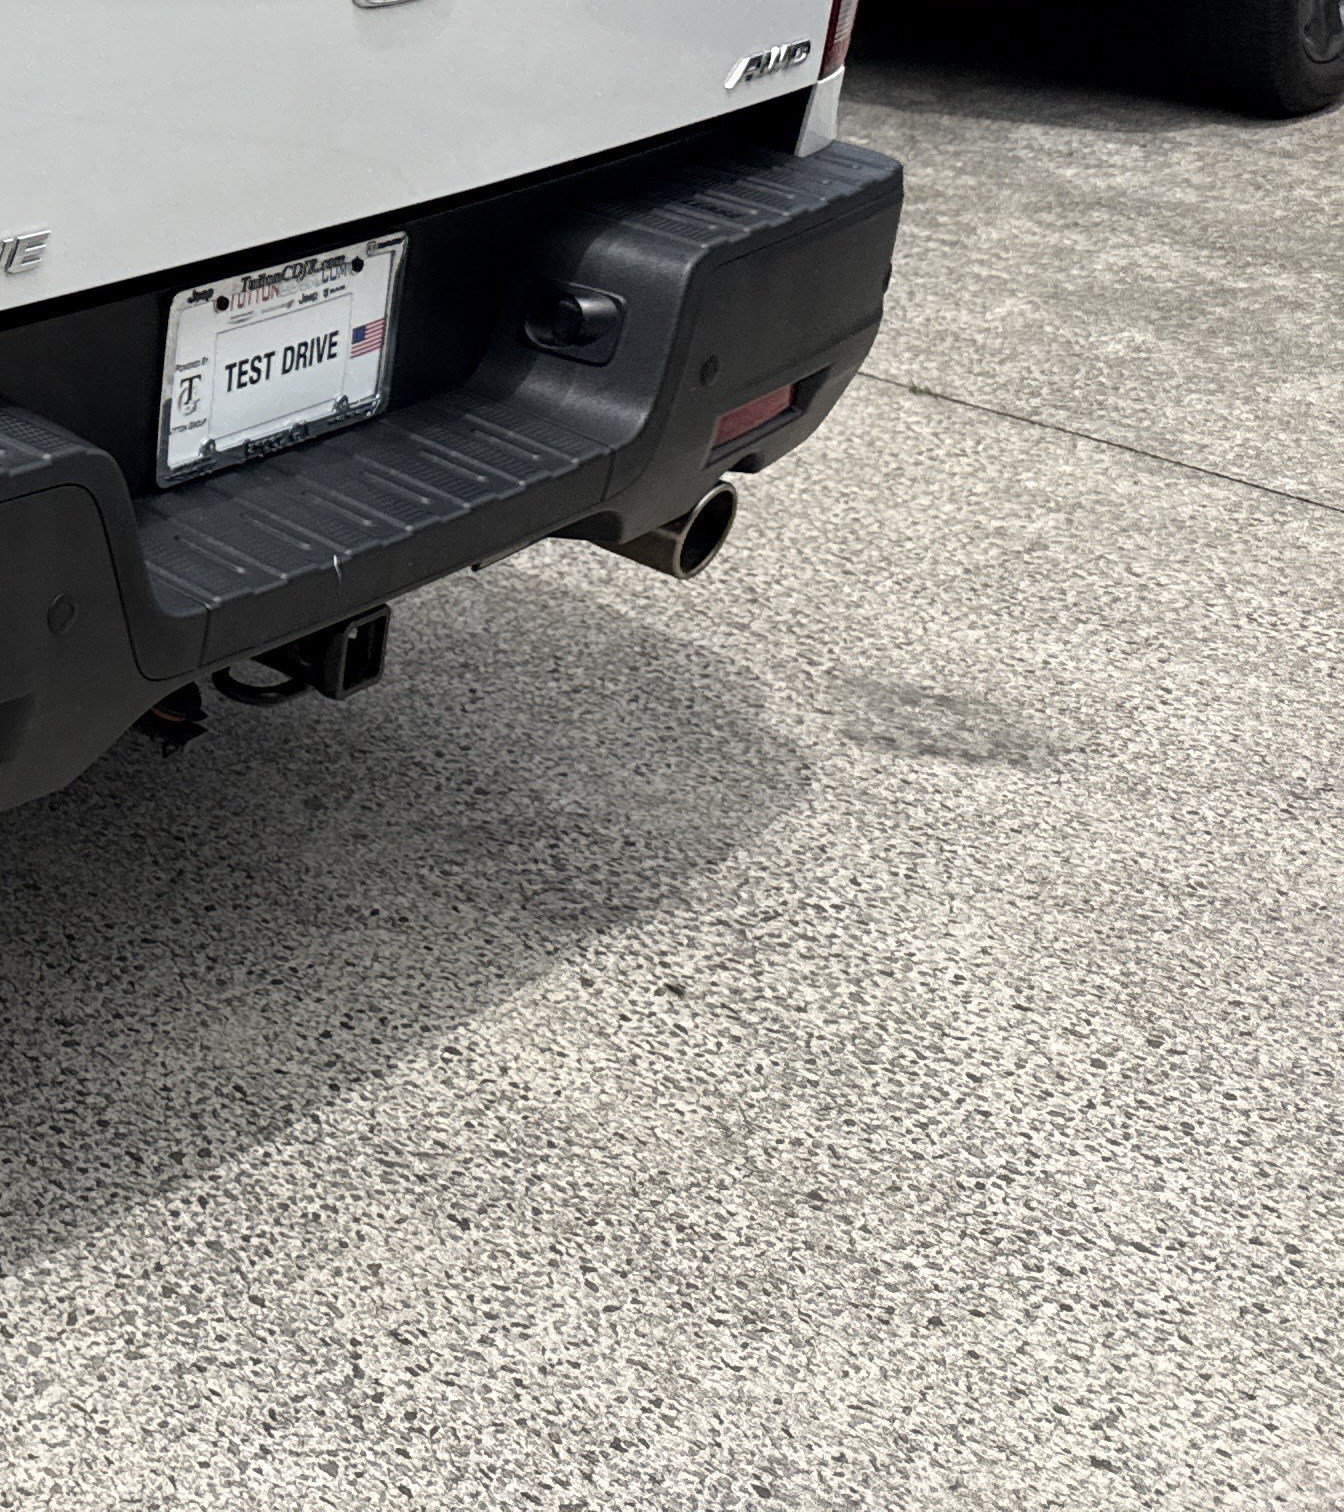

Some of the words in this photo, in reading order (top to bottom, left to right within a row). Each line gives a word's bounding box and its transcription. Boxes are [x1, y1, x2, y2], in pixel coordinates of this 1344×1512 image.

[723, 38, 812, 90] AWD
[224, 350, 277, 393] TEST
[281, 329, 340, 376] DRIVE
